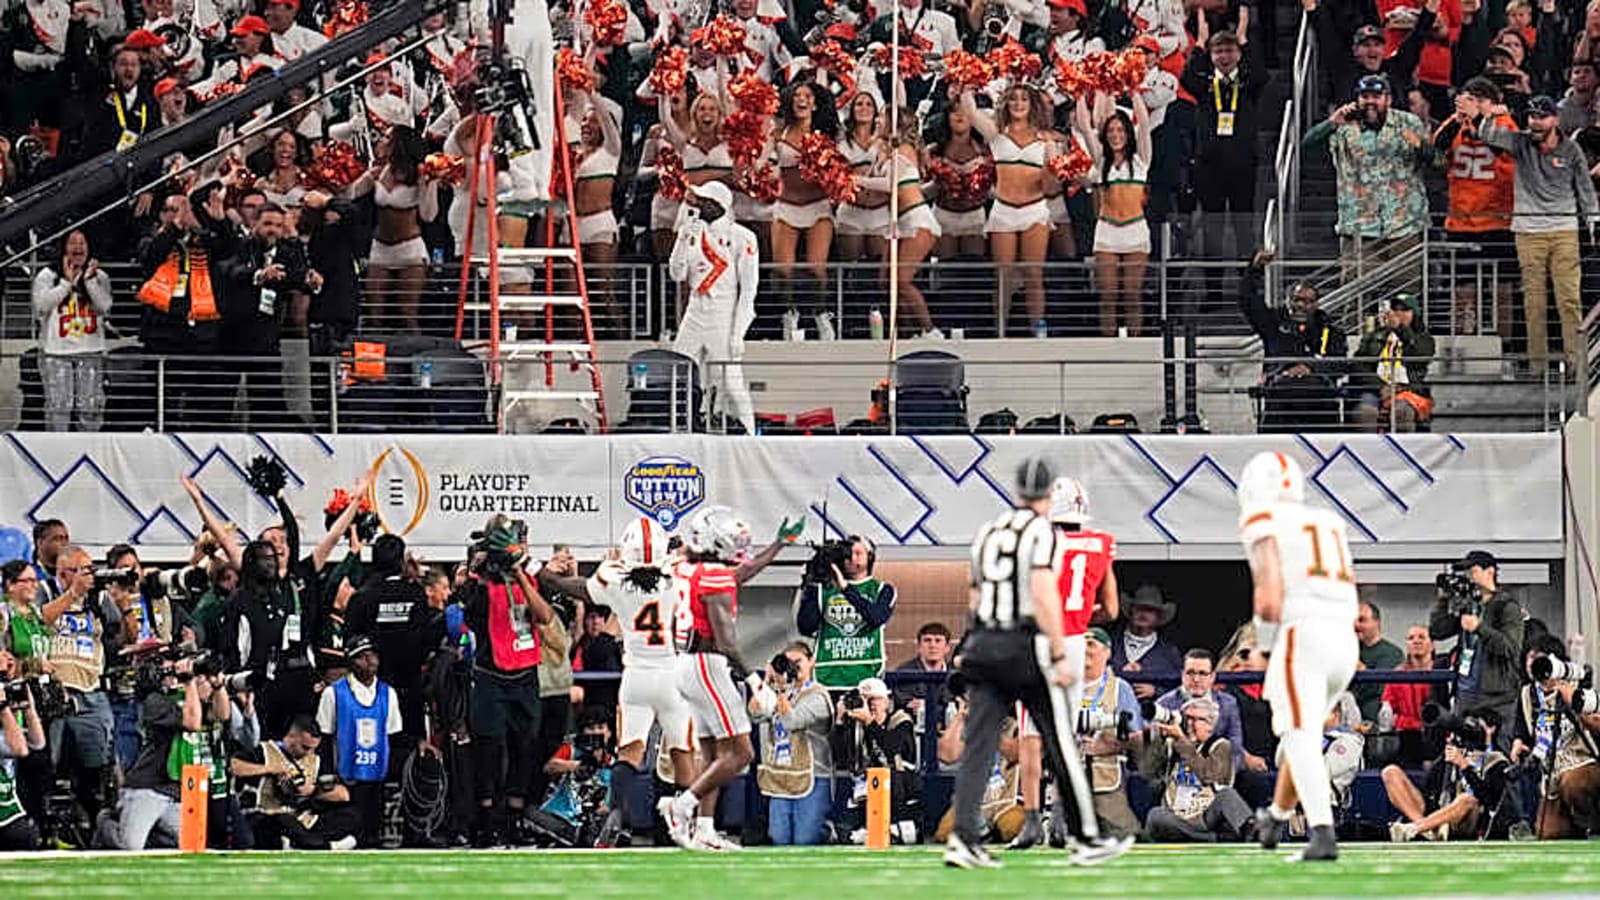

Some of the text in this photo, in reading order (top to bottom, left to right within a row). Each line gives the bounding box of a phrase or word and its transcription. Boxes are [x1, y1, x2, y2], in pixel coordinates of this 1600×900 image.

[1454, 144, 1496, 179] 52
[440, 474, 530, 491] PLAYOFF
[630, 477, 700, 501] COTTON
[440, 495, 599, 512] QUARTERFINAL
[642, 492, 688, 506] BOWL
[1302, 524, 1356, 583] 11
[1065, 553, 1087, 611] 1
[633, 599, 666, 647] 4
[824, 636, 874, 650] STADIUM
[832, 647, 865, 659] STAFF
[355, 751, 377, 765] 239
